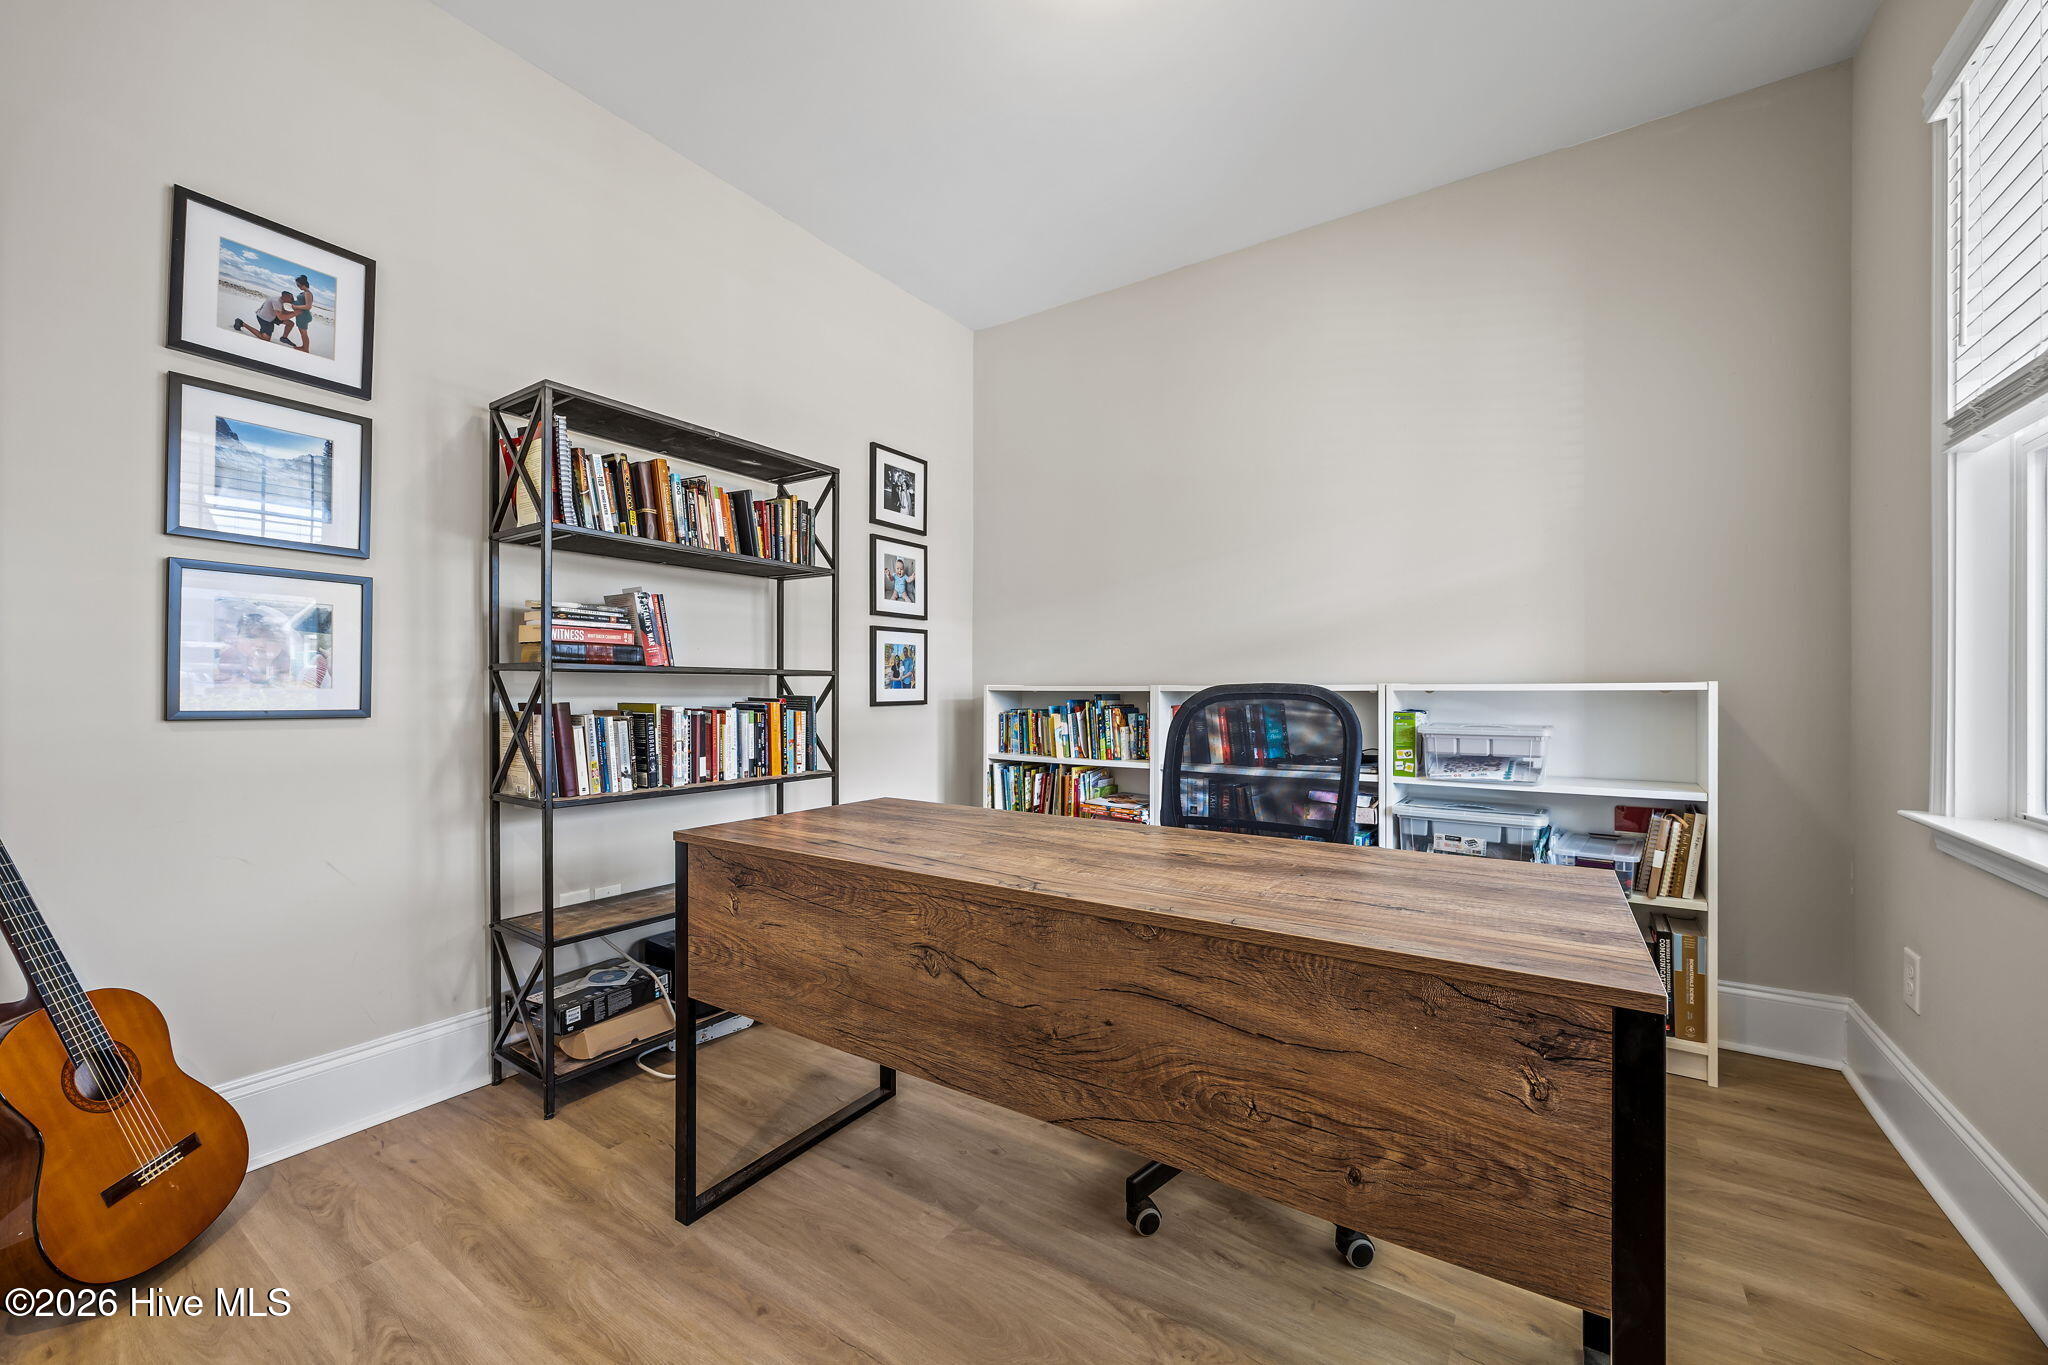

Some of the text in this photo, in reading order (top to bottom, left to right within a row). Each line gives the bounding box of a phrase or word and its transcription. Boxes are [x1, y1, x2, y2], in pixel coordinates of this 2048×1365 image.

[623, 473, 634, 510] SOCIOLOGY
[552, 628, 585, 641] WITNESS
[640, 603, 653, 631] STALIN'S
[647, 632, 656, 647] WAR
[648, 722, 656, 761] ENDURANCE
